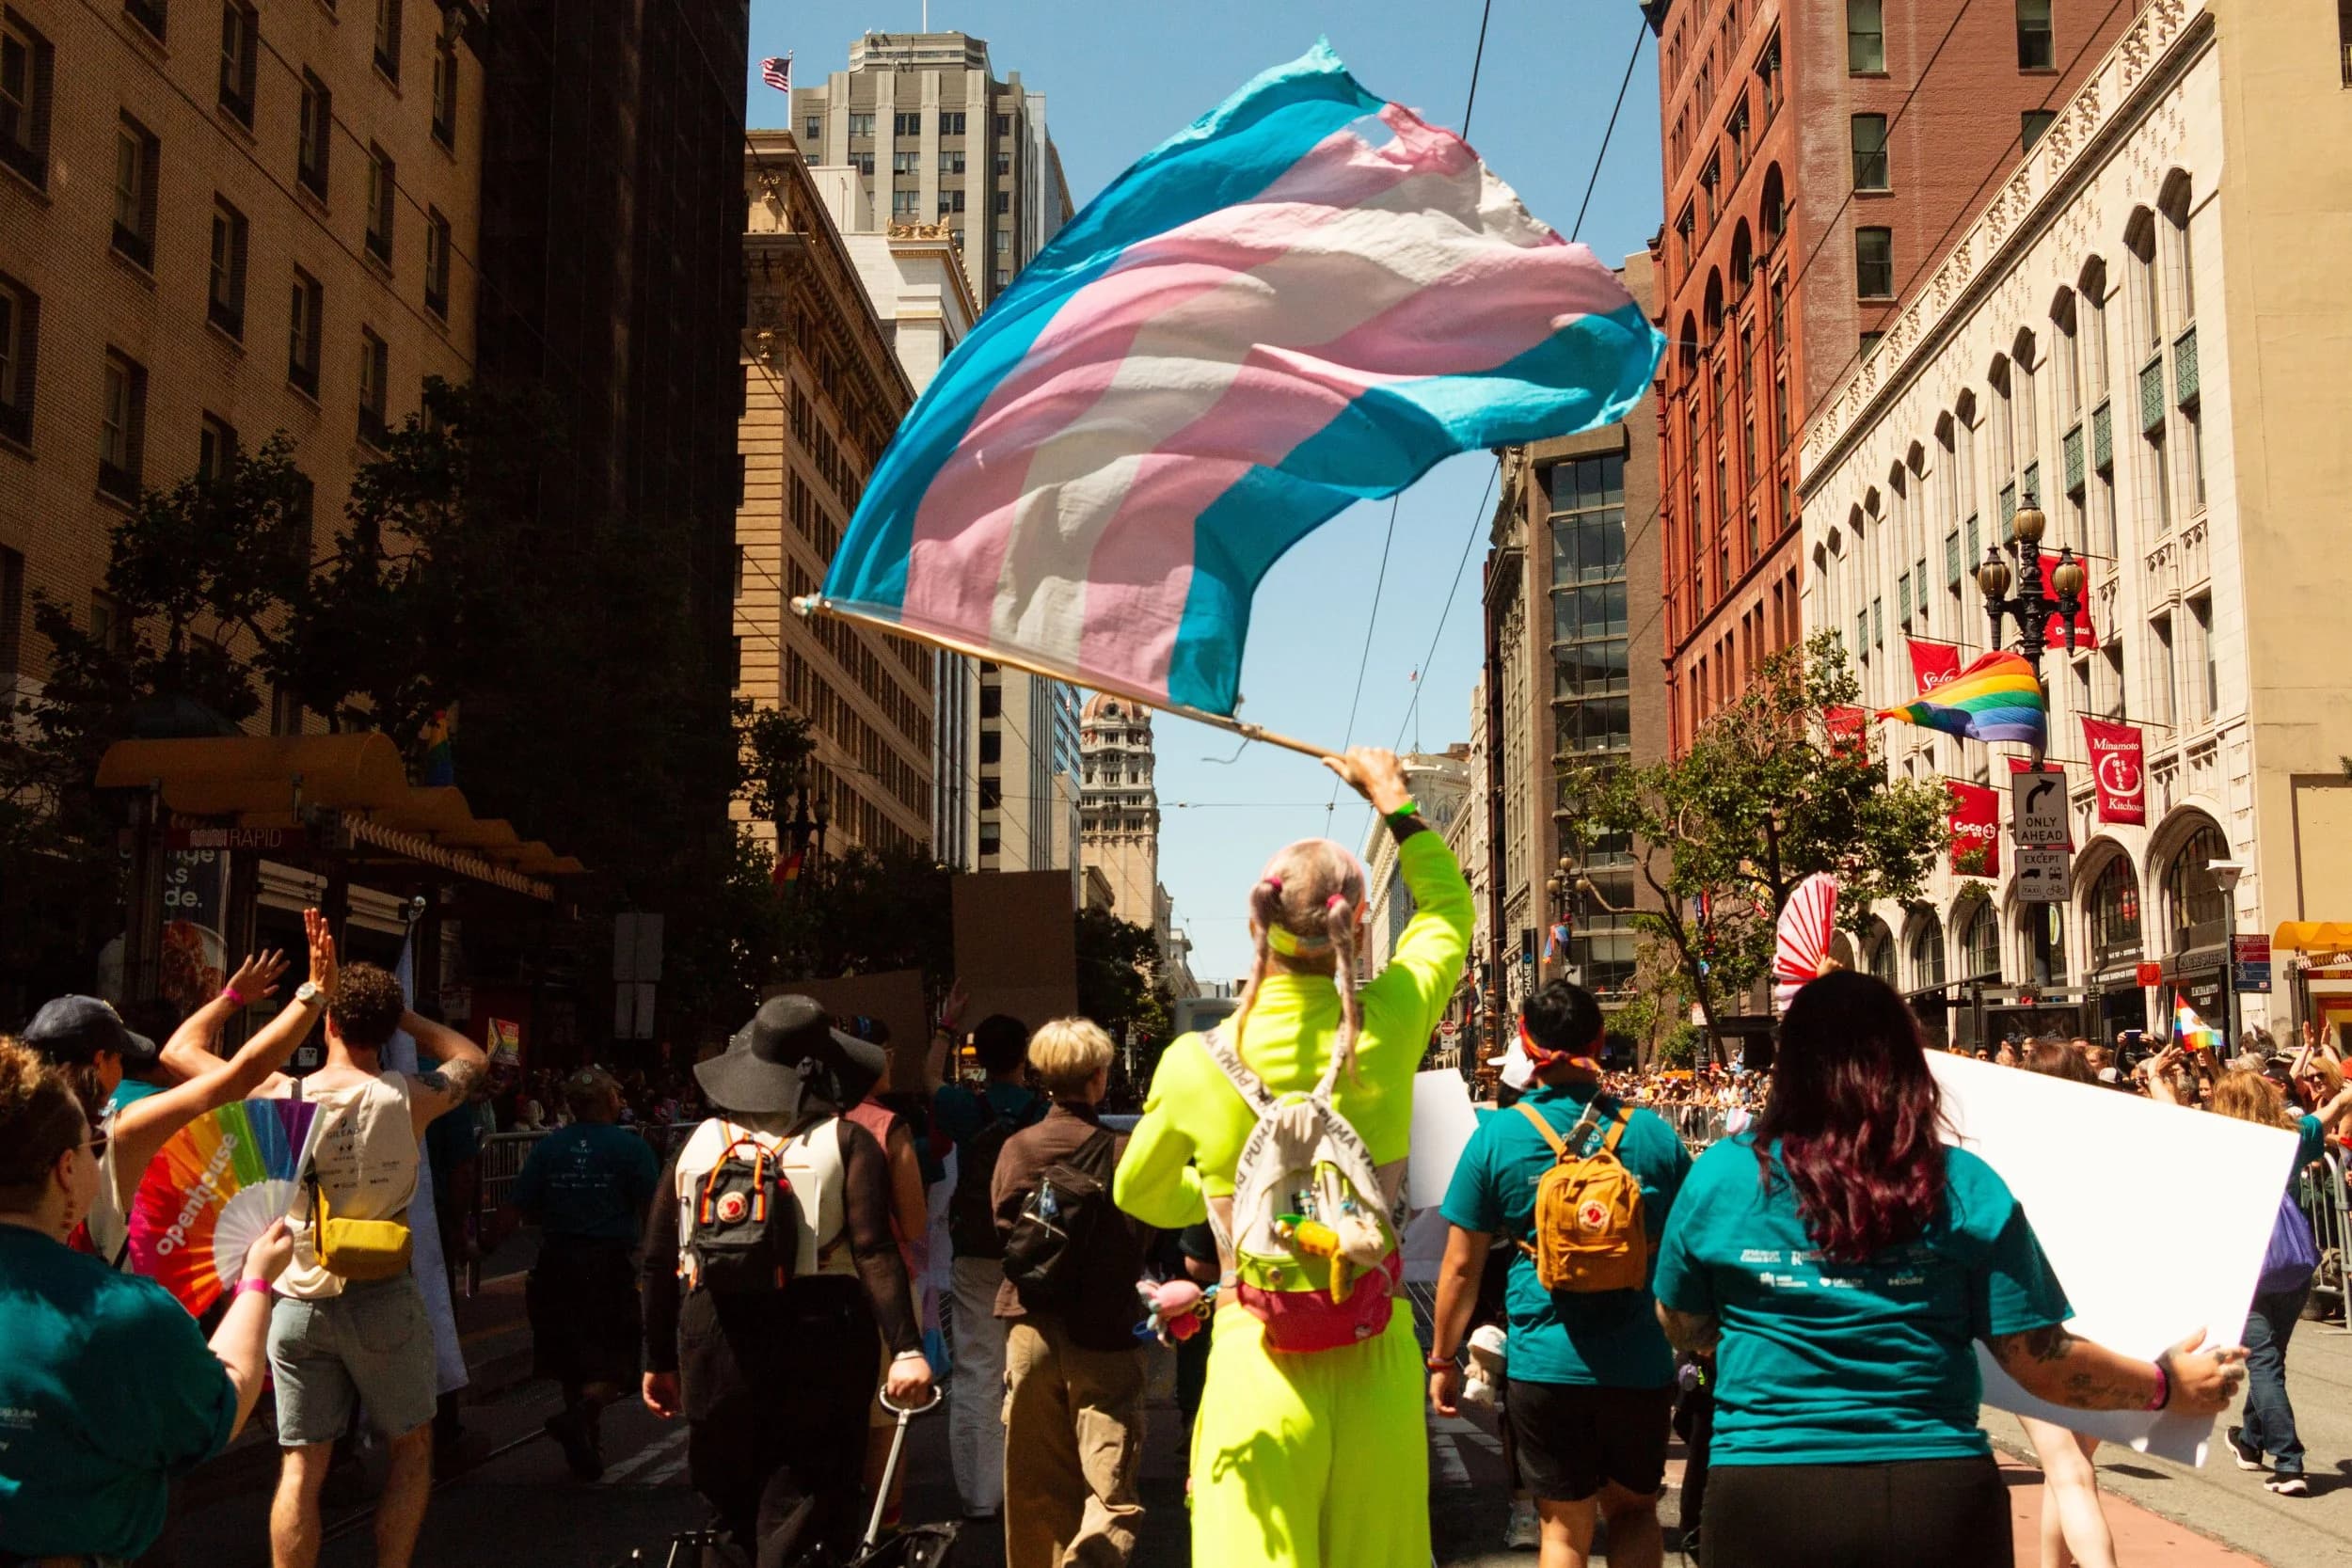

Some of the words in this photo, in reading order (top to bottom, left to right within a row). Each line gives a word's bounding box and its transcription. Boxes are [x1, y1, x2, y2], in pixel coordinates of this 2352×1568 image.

[2093, 737, 2139, 751] Minamoto
[2108, 798, 2144, 813] Kitchoan
[2026, 816, 2058, 828] ONLY
[230, 828, 281, 847] RAPID
[2022, 830, 2063, 842] AHEAD
[2024, 854, 2059, 864] EXCEPT
[2024, 886, 2040, 895] TAXI
[1524, 964, 1533, 997] CHASE
[1319, 1107, 1358, 1150] PUMA
[1244, 1118, 1274, 1167] PUMA
[155, 1132, 238, 1256] openhouse
